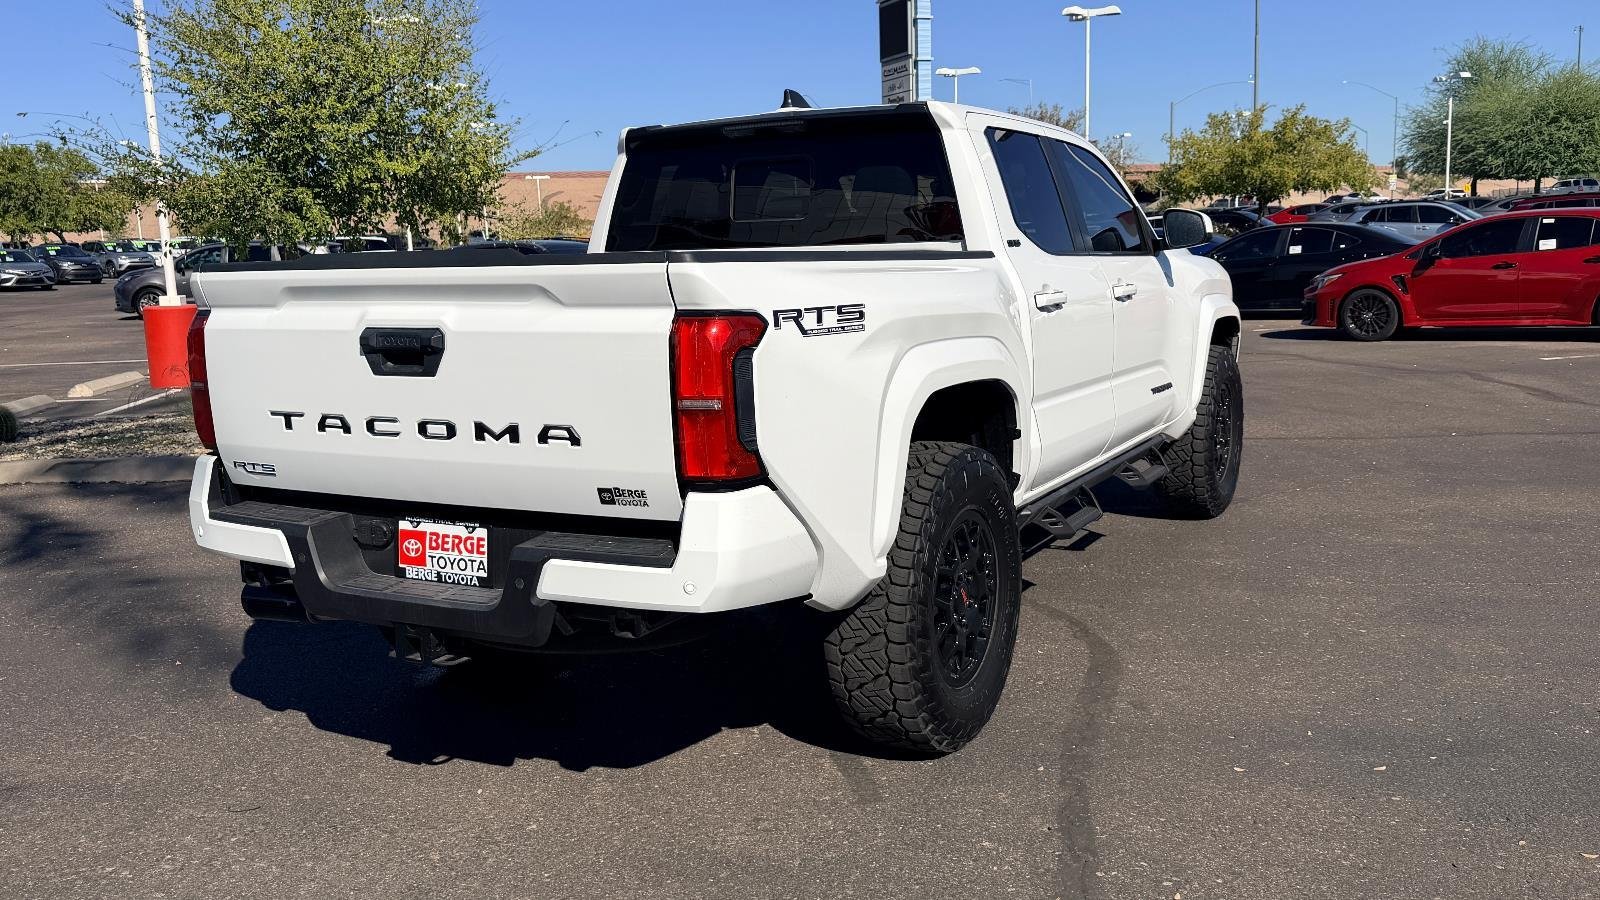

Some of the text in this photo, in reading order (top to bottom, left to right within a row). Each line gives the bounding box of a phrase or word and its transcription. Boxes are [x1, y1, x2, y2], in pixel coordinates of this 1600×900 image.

[772, 303, 865, 336] RTS
[379, 335, 418, 347] TOYOTA
[268, 409, 583, 447] TACOMA
[233, 460, 276, 475] RTS
[612, 486, 648, 499] BERGE
[615, 498, 650, 507] TOYOTA
[428, 531, 486, 556] BERGE
[428, 554, 487, 573] TOYOTA
[405, 566, 480, 586] BERGE TOYOTA
